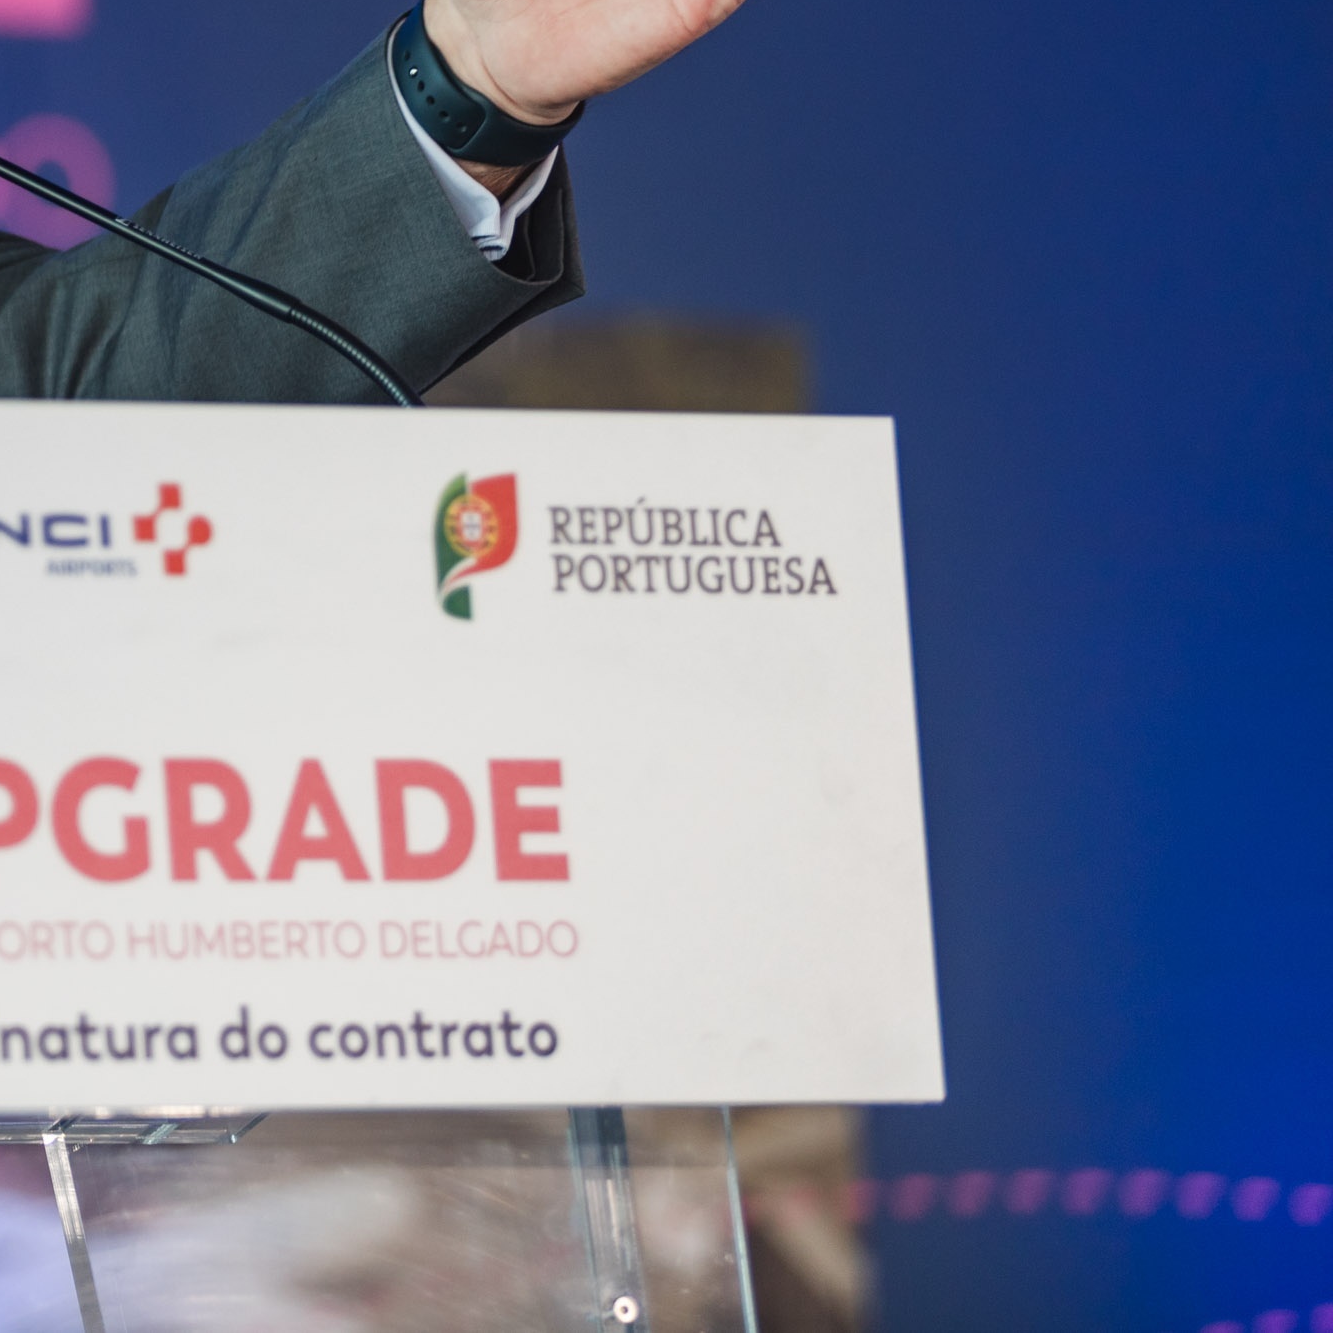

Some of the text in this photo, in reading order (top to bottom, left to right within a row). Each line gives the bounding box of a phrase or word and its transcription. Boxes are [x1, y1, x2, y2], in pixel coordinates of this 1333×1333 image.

[547, 497, 782, 548] REPÚBLICA
[552, 553, 838, 596] PORTUGUESA
[126, 919, 367, 961] HUMBERTO
[378, 918, 581, 960] DELGADO
[218, 1005, 289, 1061] do
[307, 1010, 559, 1060] contrato
